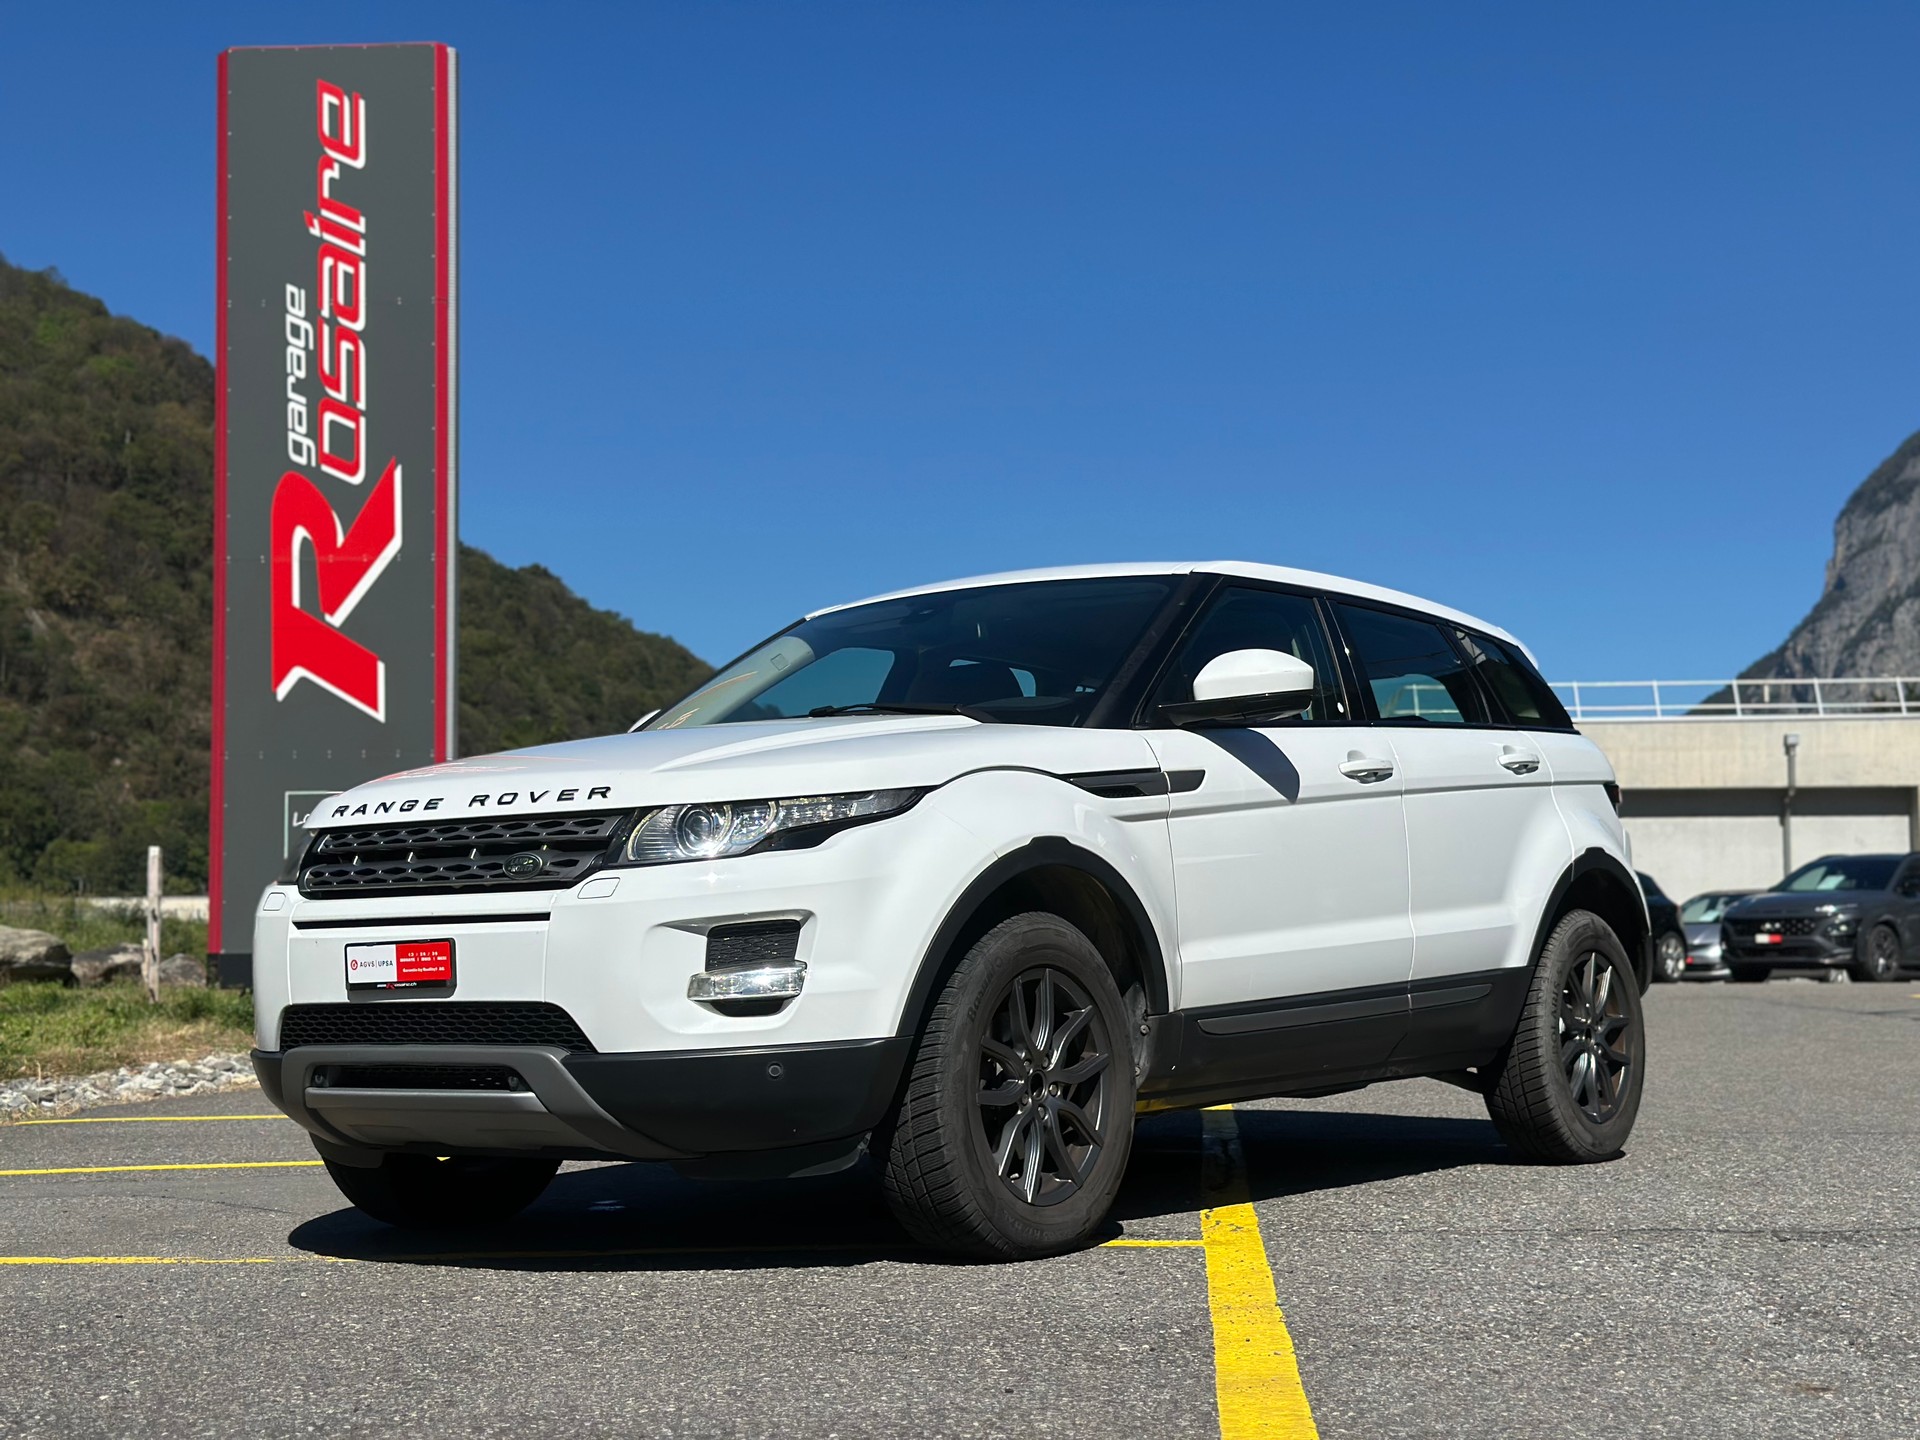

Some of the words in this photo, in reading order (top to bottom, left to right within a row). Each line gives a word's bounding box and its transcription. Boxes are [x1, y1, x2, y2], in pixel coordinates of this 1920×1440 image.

[269, 77, 403, 722] Rosaire
[285, 282, 316, 467] garage
[331, 797, 445, 818] RANGE
[468, 785, 612, 808] ROVER
